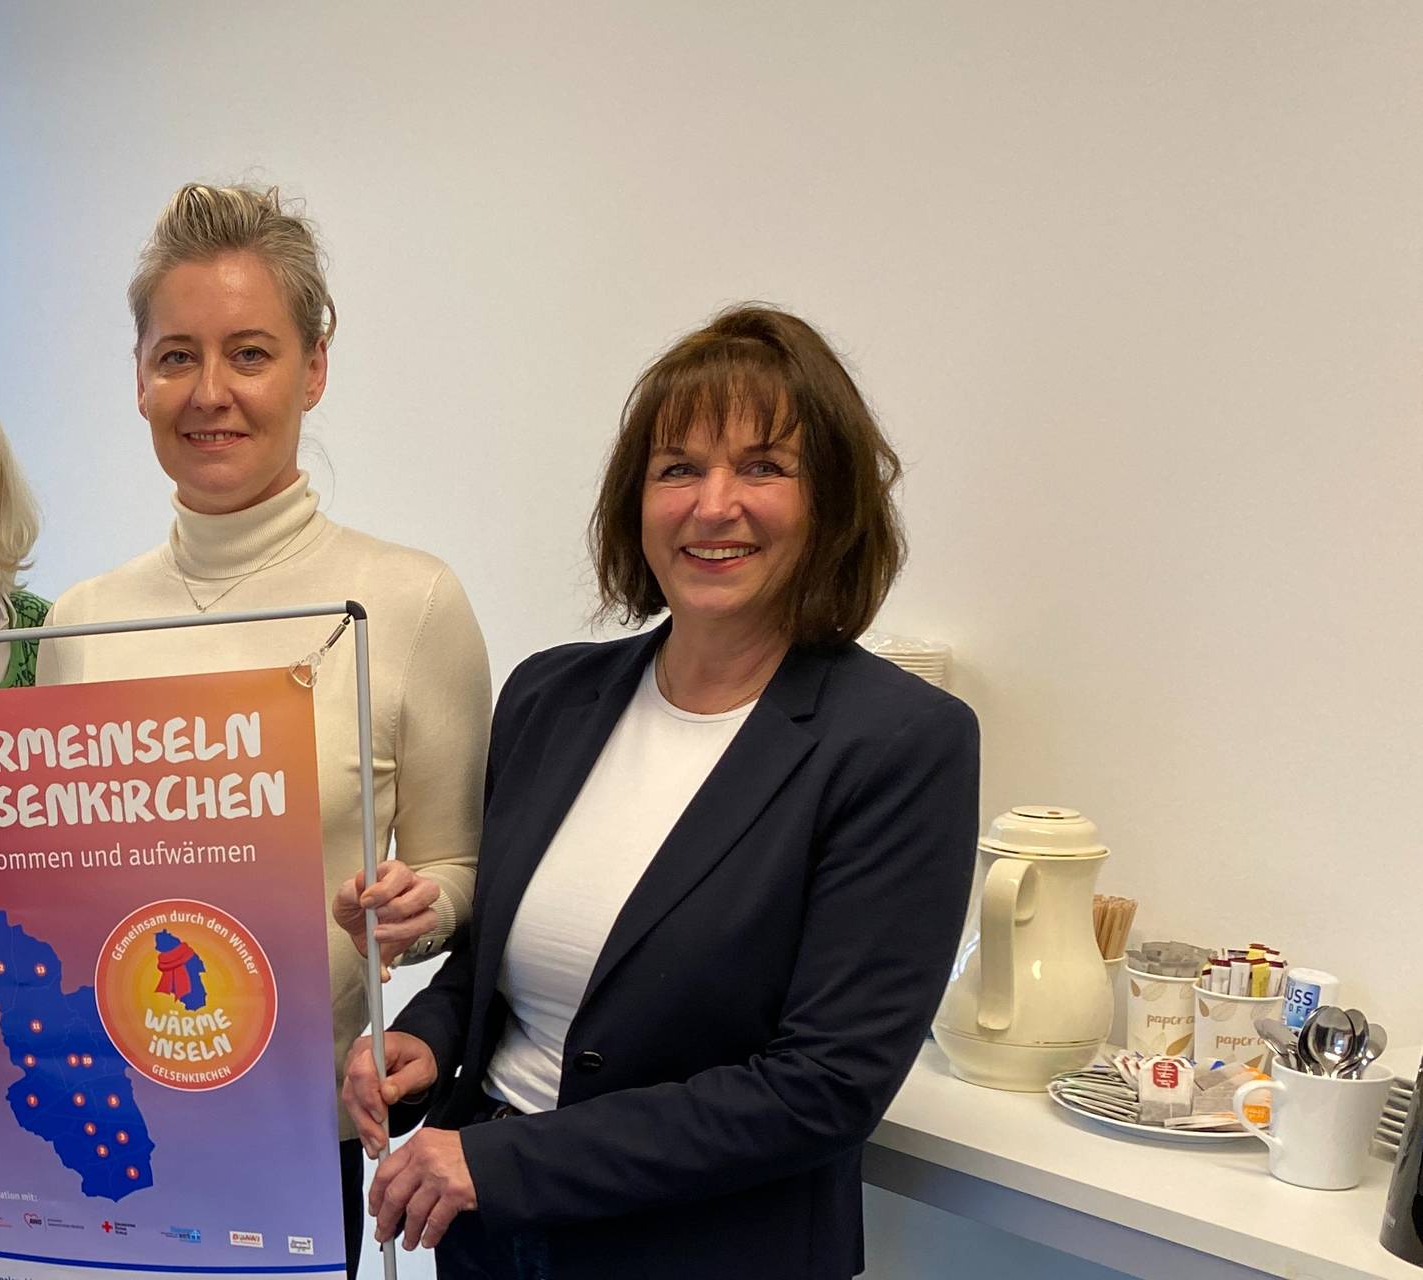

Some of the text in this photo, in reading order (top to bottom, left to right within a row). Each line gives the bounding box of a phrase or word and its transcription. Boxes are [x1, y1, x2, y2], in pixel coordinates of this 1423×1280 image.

[80, 843, 122, 868] und
[129, 841, 257, 866] aufwärmen
[170, 910, 204, 926] durch
[206, 918, 229, 938] den
[228, 933, 259, 976] Winter
[145, 1008, 232, 1037] WÄRME
[1147, 1014, 1184, 1030] paper
[1216, 1035, 1255, 1051] paper
[152, 1064, 231, 1083] GELSENKIRCHEN
